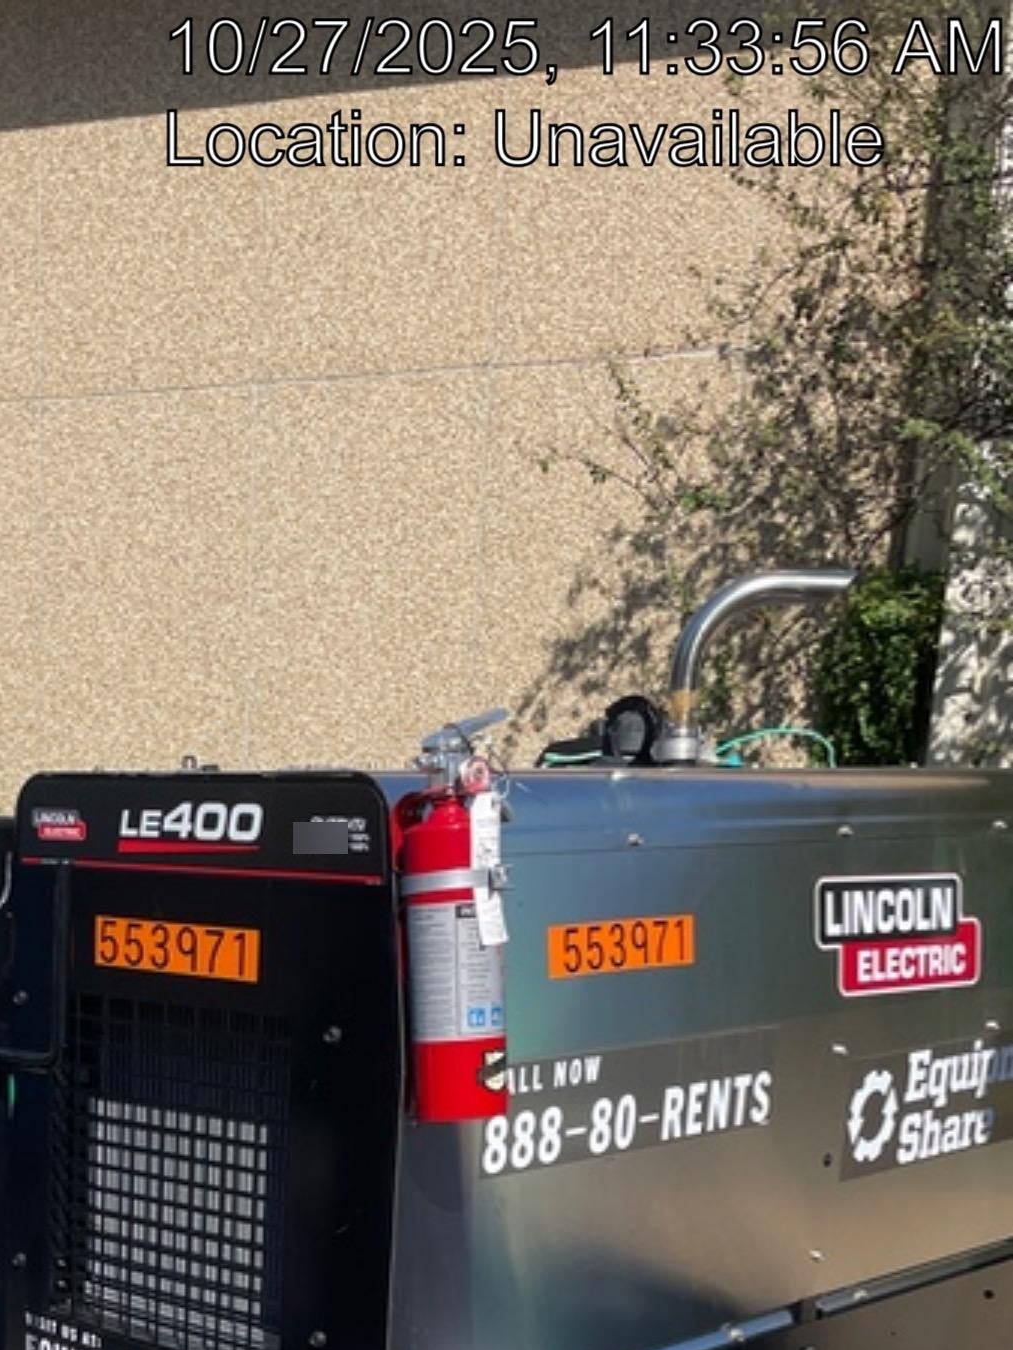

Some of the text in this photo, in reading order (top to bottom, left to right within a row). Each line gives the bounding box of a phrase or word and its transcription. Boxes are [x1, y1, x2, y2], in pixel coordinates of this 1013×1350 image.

[119, 802, 263, 841] LE400
[825, 887, 954, 937] LINCOLN
[99, 920, 247, 977] 553971
[563, 920, 686, 973] 553971
[856, 944, 967, 983] ELECTRIC
[506, 1055, 602, 1095] ALL NOW
[482, 1070, 772, 1175] 888-80-RENTS
[896, 1108, 993, 1165] Share
